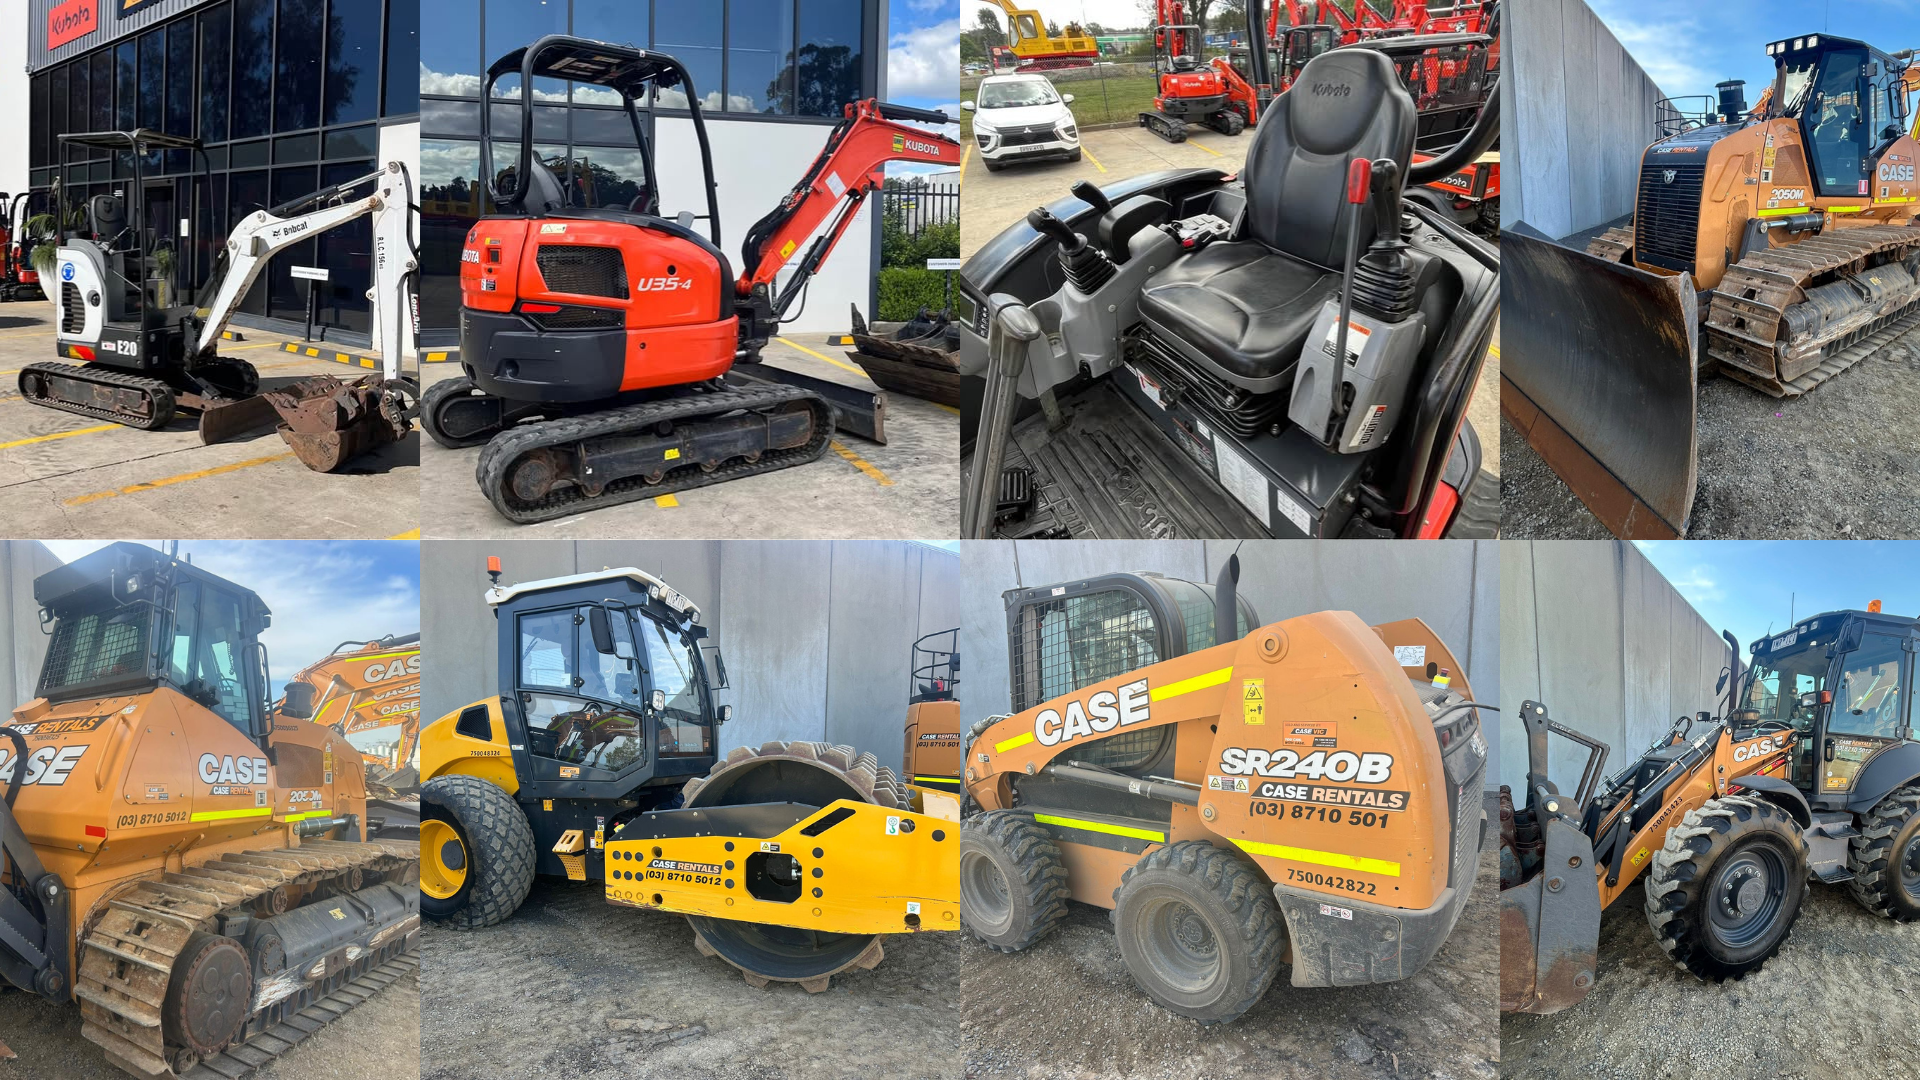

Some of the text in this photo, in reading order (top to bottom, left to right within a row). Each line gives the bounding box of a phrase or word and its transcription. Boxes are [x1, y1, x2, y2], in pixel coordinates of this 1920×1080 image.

[52, 5, 90, 35] Kubota
[1313, 83, 1351, 96] Kubota
[905, 139, 940, 156] KUBOTA
[1879, 163, 1914, 182] CASE
[1770, 188, 1805, 200] 2050M
[283, 221, 308, 236] Bobcat
[637, 277, 692, 292] U35-4
[117, 340, 137, 356] E20
[363, 655, 420, 683] CAS
[380, 700, 420, 715] CASE
[1034, 677, 1150, 747] CASE
[33, 718, 99, 734] RENTALS
[1733, 735, 1783, 762] CASE
[198, 752, 267, 784] CASE
[1219, 747, 1395, 784] SR240B
[213, 786, 229, 795] CASE
[1261, 784, 1308, 800] CASE
[1311, 787, 1404, 809] RENTALS
[117, 811, 187, 829] (03) 8710 5012
[1250, 801, 1389, 829] (03) 8710 501
[1649, 796, 1683, 833] 750043423
[652, 859, 720, 874] CASE RENTALS
[645, 870, 722, 886] (03) 8710 5012
[1287, 868, 1377, 896] 750042822
